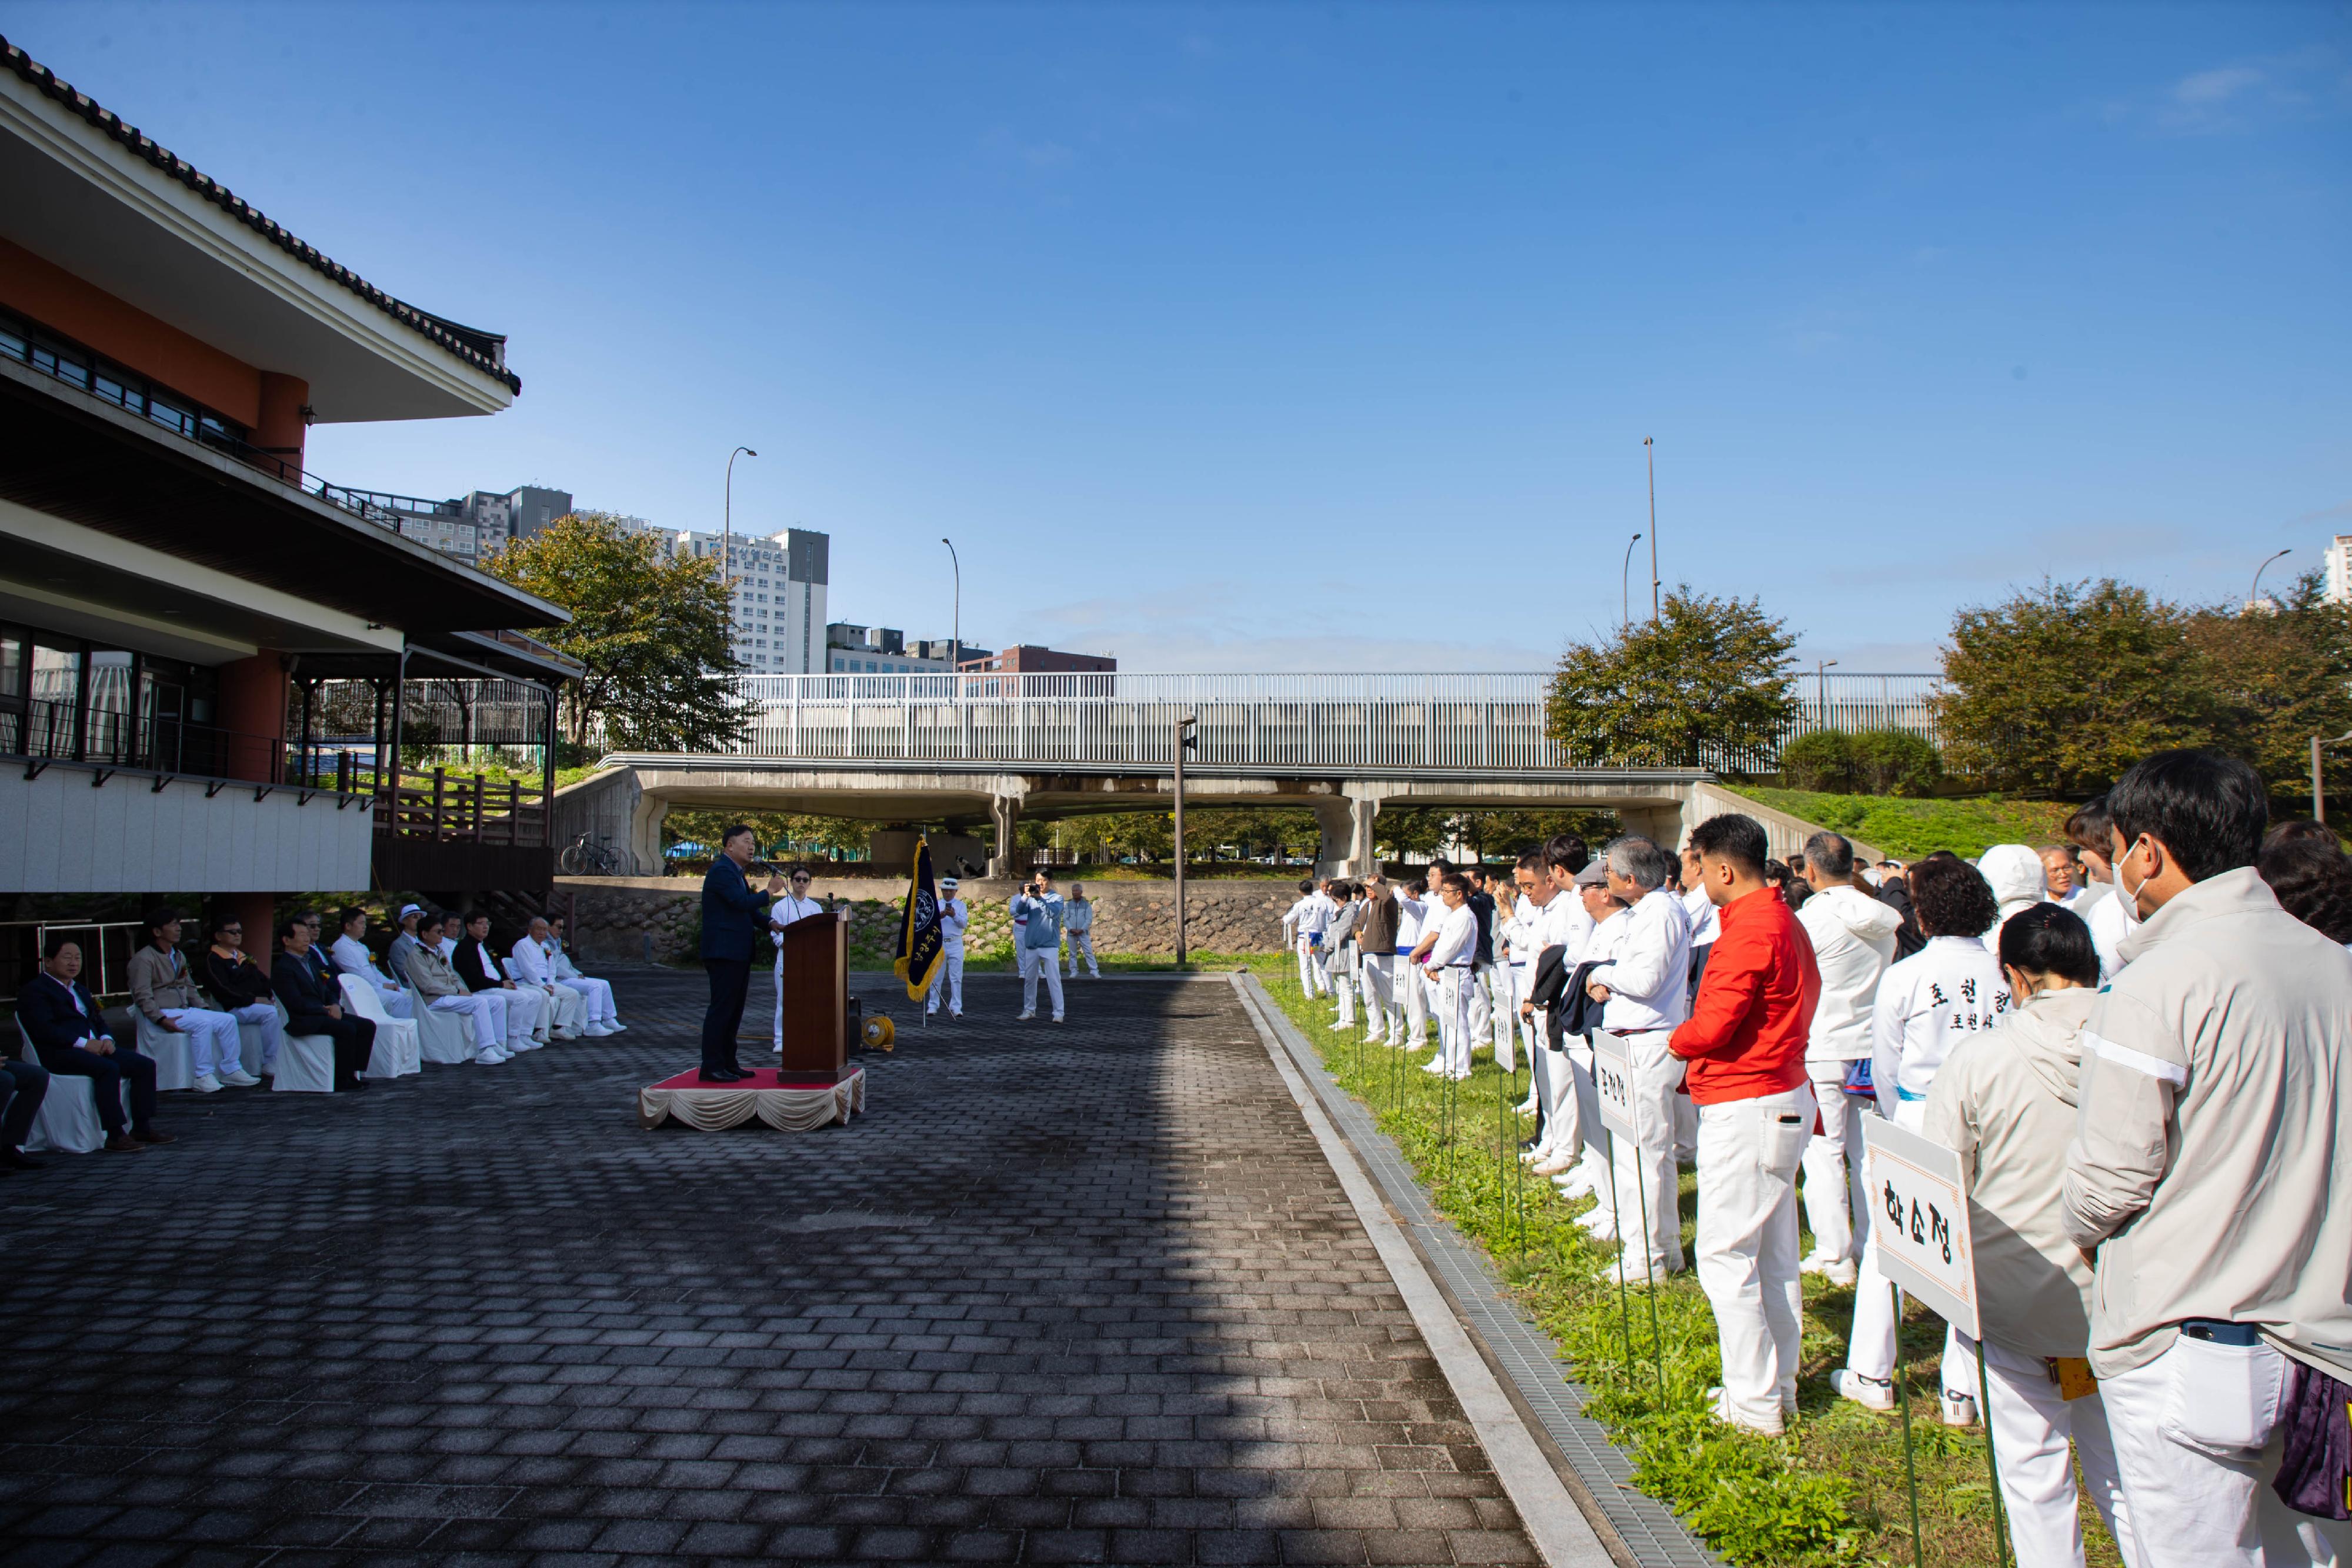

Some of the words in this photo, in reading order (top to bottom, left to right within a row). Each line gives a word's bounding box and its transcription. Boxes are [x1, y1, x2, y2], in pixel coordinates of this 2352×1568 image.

[915, 926, 941, 961] 남양주시
[1929, 978, 2011, 1013] 포천정
[1950, 1013, 1993, 1030] 포천시
[1884, 1180, 1951, 1264] 학소정
